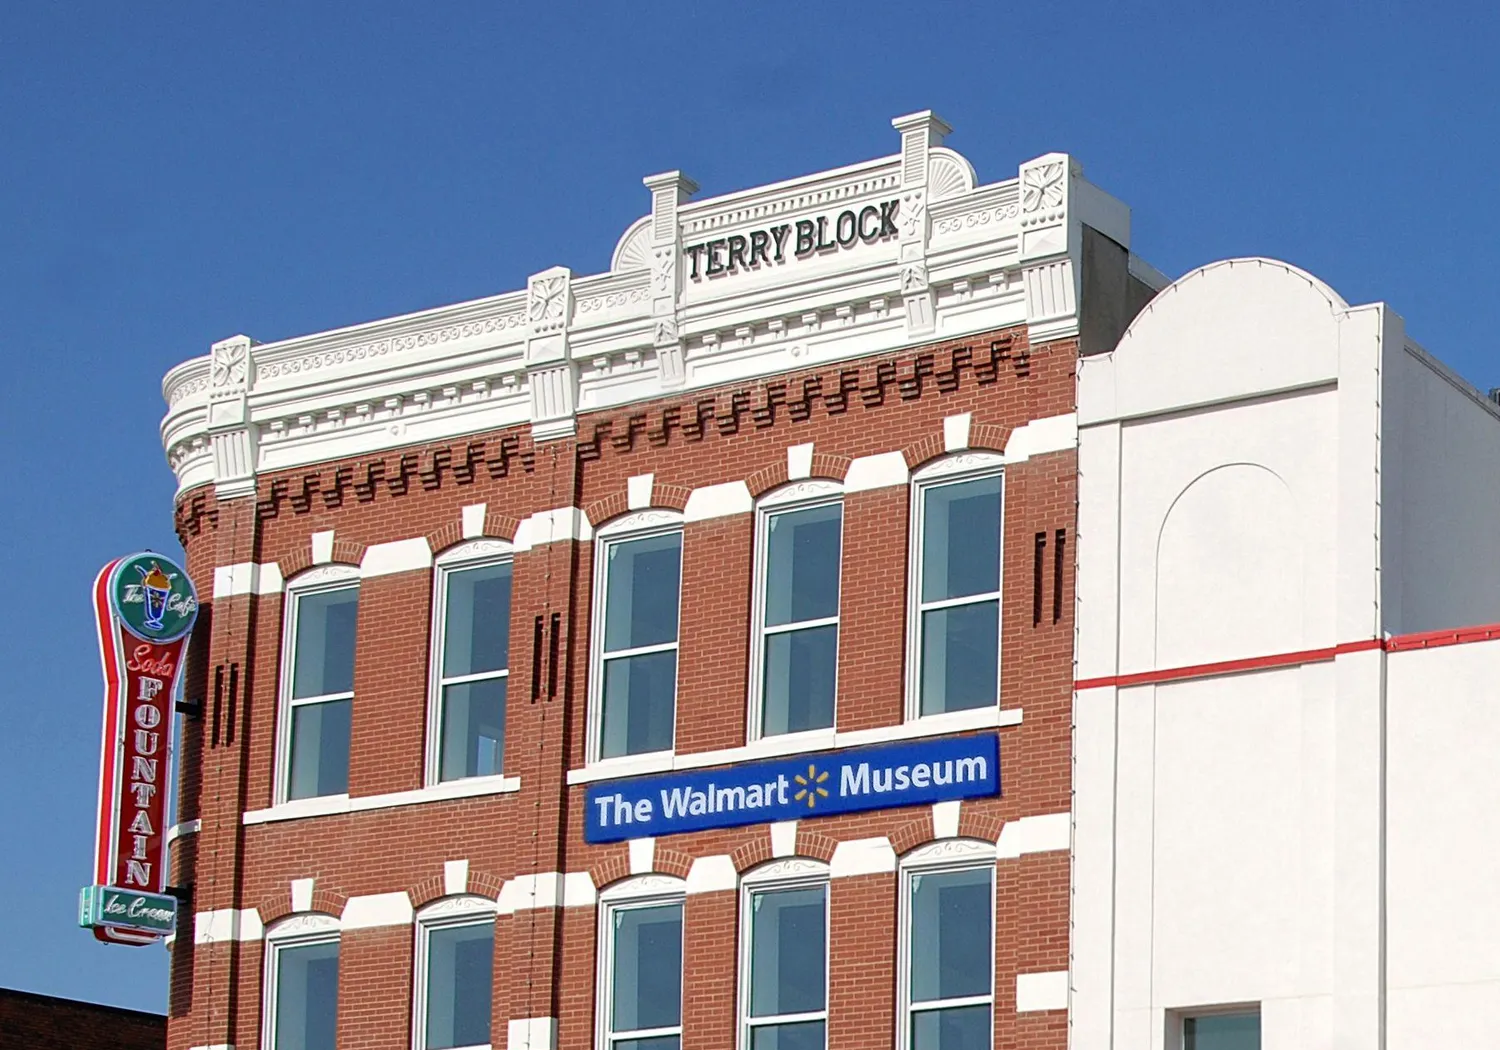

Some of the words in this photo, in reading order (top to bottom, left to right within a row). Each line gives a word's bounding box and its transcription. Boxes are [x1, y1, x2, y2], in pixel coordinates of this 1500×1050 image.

[684, 223, 792, 283] TERRY
[794, 200, 900, 259] BLOCK
[123, 584, 145, 603] The
[127, 644, 173, 677] Soda
[124, 675, 163, 887] FOUNTAIN
[595, 794, 652, 826] The
[660, 774, 789, 819] Walmart
[839, 756, 987, 796] Museum
[104, 894, 127, 914] Ice
[128, 896, 175, 922] Cream
